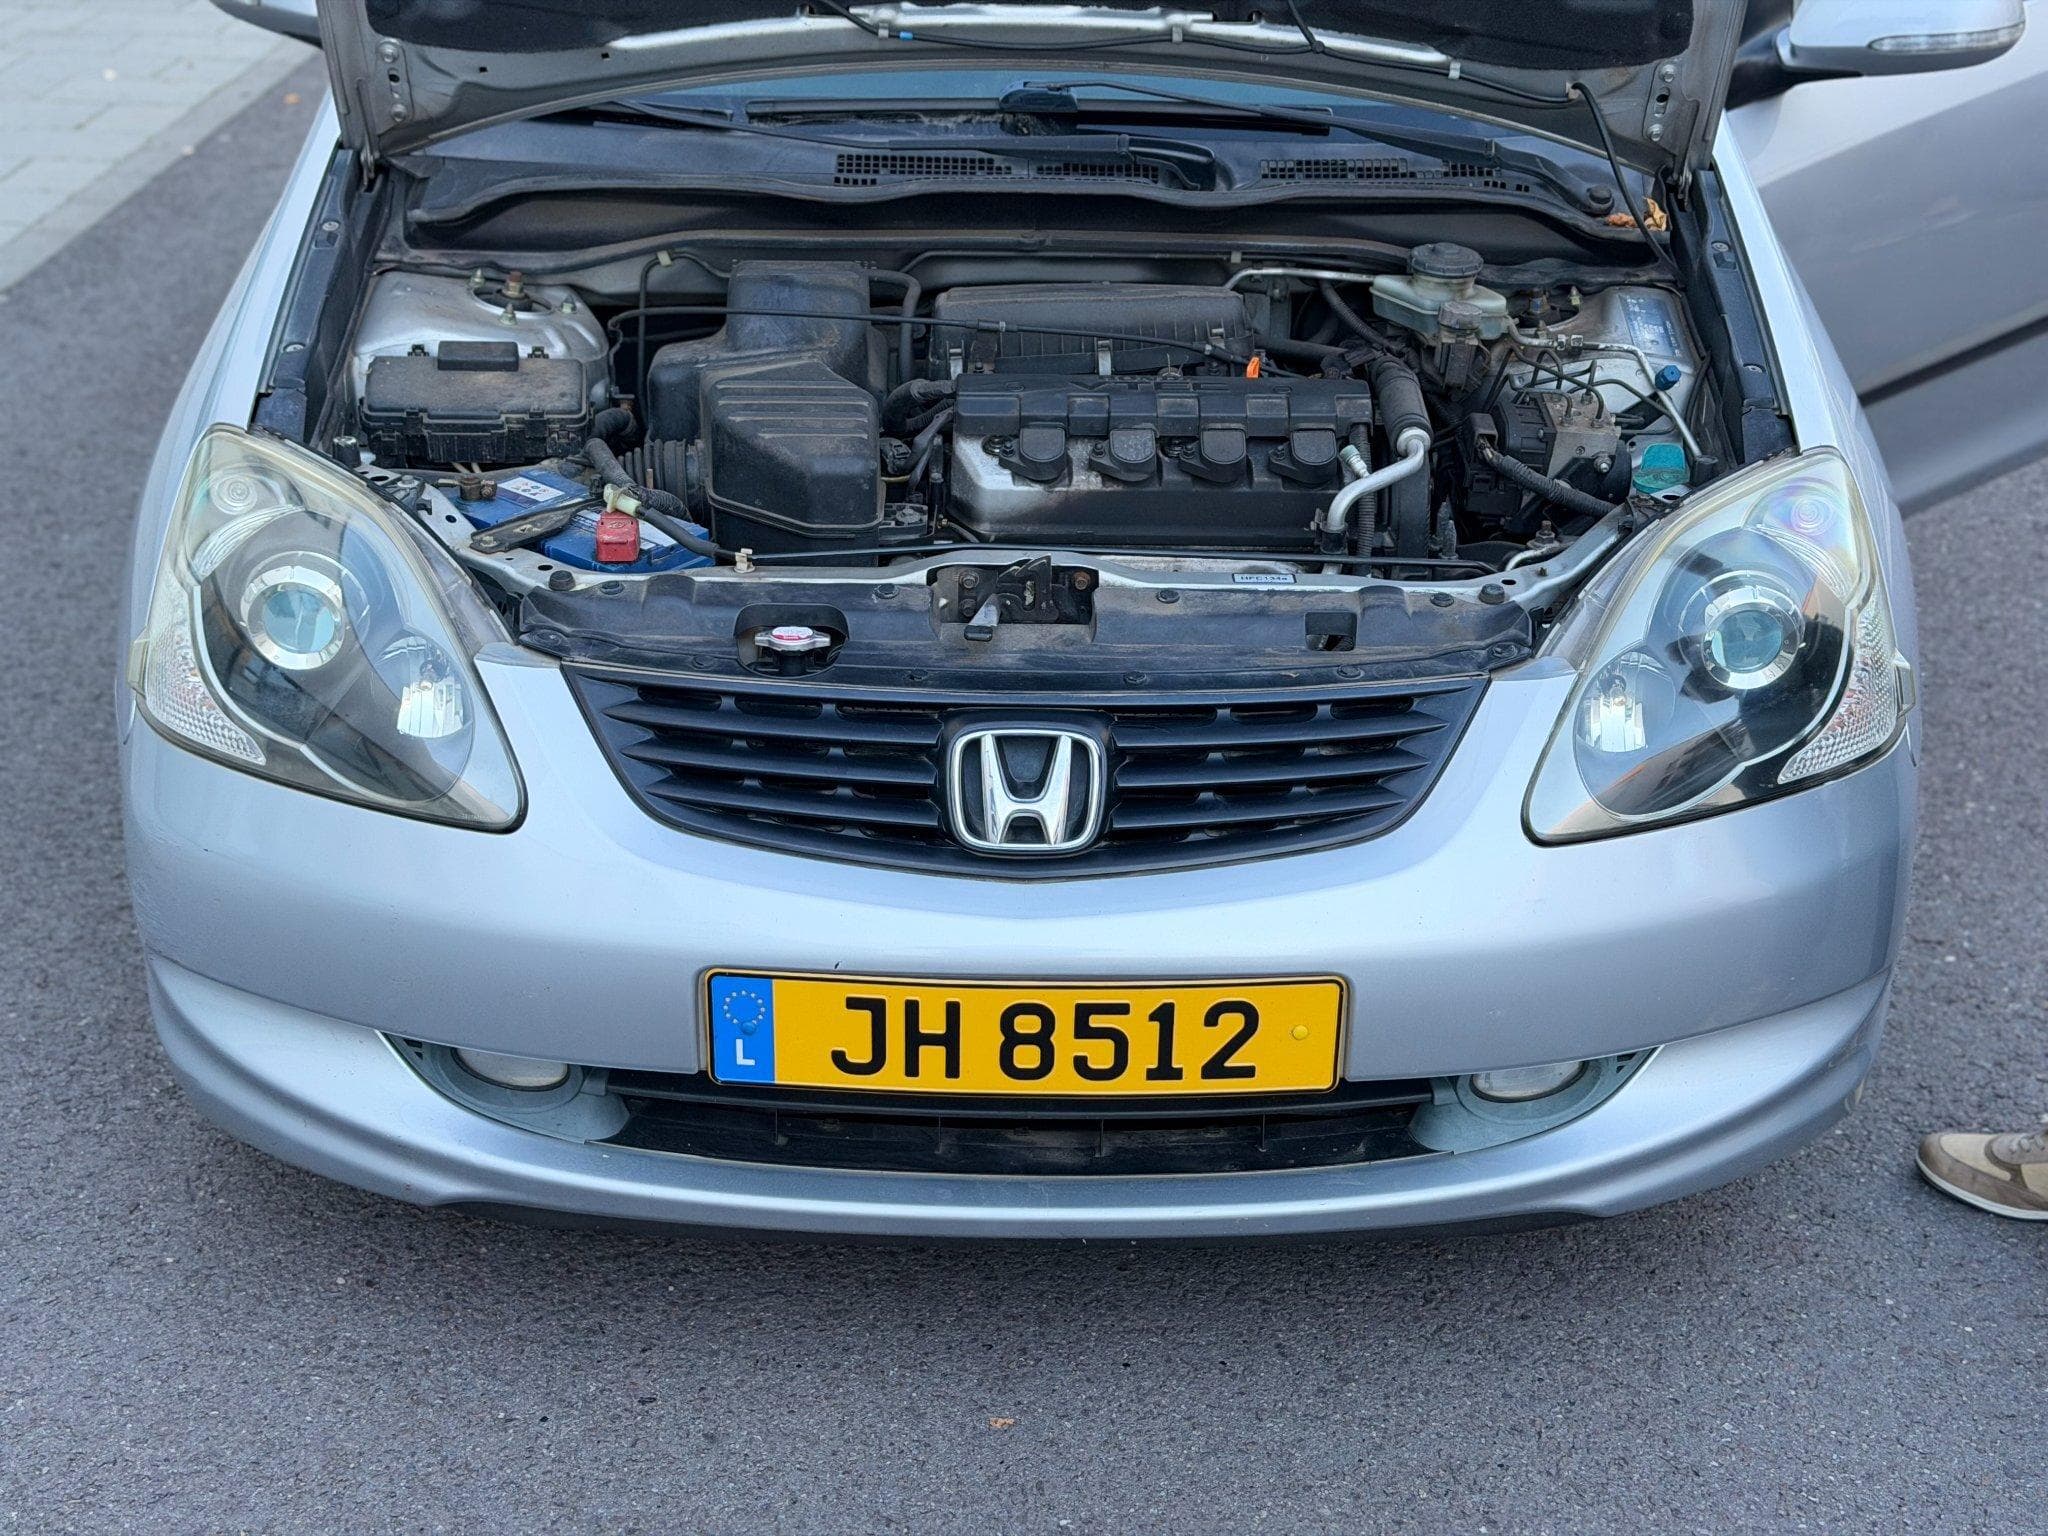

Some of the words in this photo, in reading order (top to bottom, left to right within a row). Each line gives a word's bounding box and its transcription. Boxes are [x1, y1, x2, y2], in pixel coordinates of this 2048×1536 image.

[735, 1038, 756, 1066] L
[831, 996, 961, 1079] JH
[999, 1000, 1260, 1081] 8512
